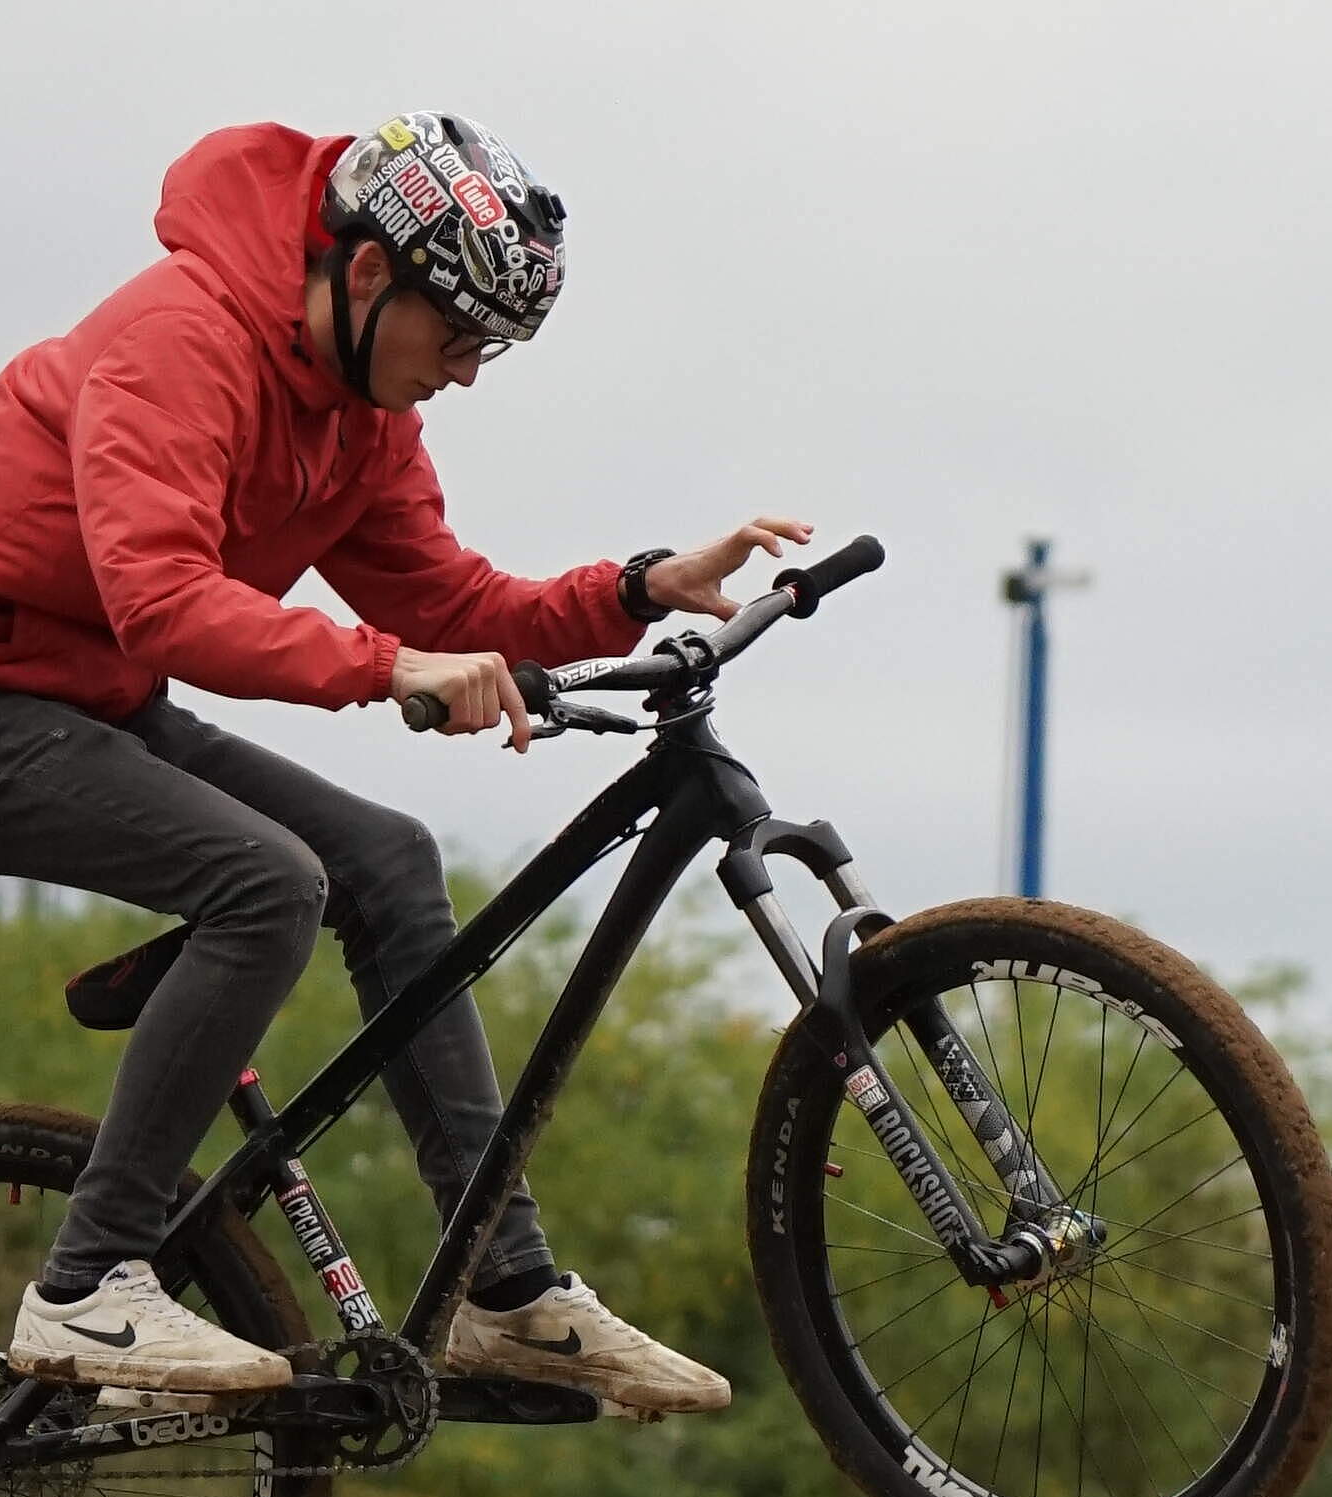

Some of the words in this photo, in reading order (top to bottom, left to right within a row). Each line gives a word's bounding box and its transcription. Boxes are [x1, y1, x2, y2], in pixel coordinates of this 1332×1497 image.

[357, 148, 417, 204] INDUSTRIES
[393, 162, 448, 223] ROCK
[370, 186, 421, 249] SHOX
[484, 311, 519, 338] INDUST
[848, 1070, 877, 1095] ROCK
[771, 1097, 802, 1235] KENDA
[285, 1196, 333, 1262] CPGANG
